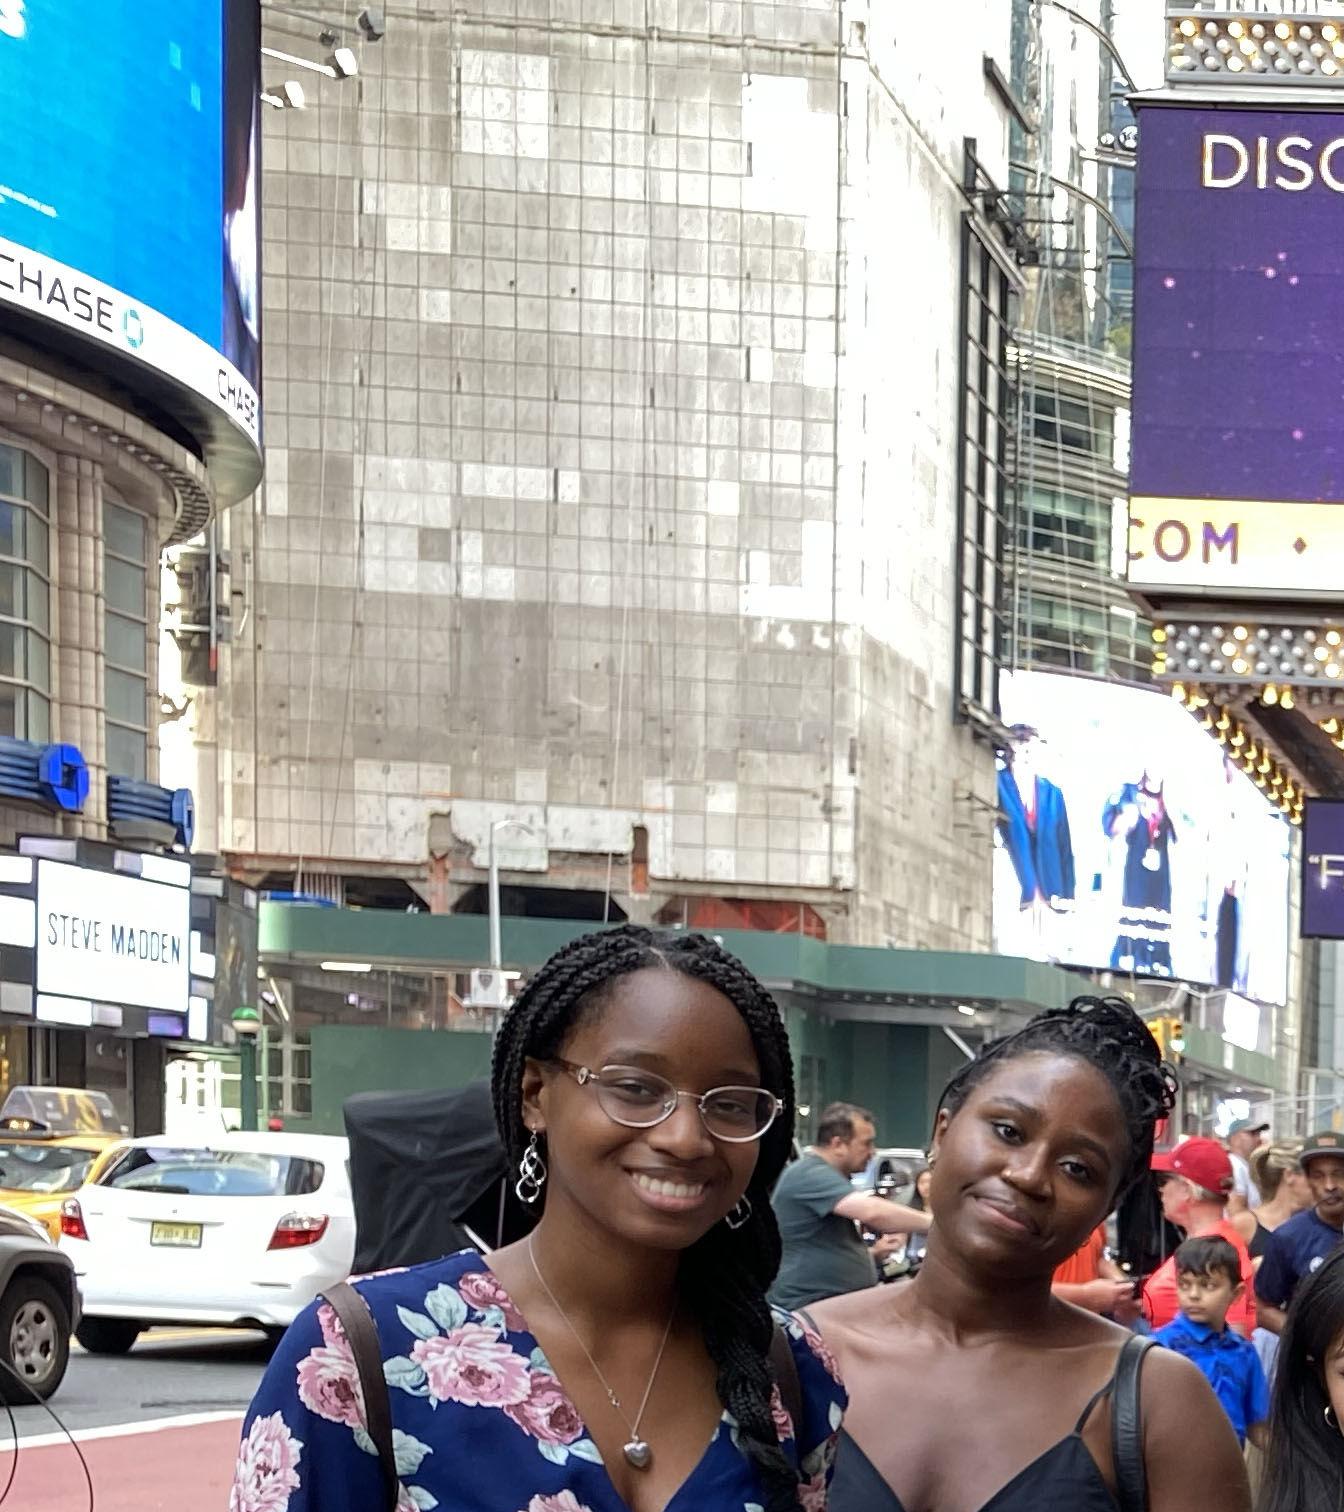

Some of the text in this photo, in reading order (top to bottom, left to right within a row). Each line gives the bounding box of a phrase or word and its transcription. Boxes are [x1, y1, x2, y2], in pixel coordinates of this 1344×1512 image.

[217, 368, 256, 430] CHASE
[47, 912, 181, 966] STEVE MADDEN
